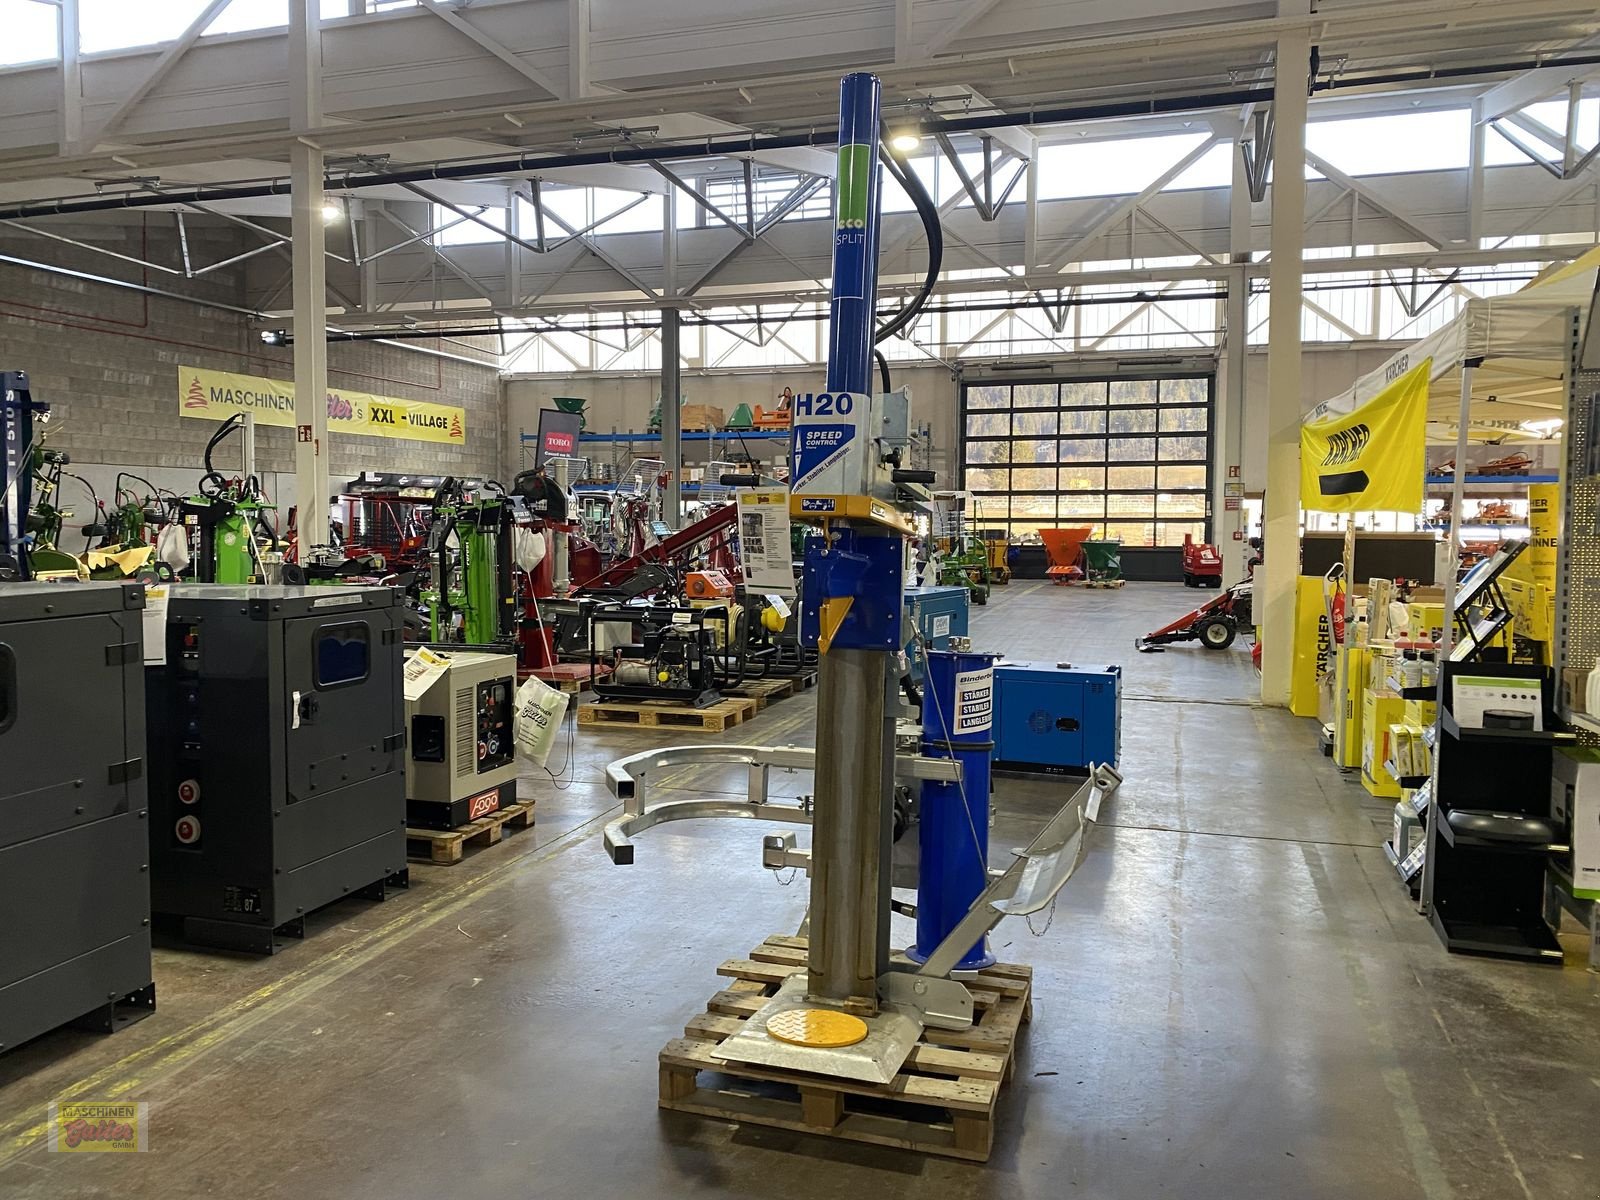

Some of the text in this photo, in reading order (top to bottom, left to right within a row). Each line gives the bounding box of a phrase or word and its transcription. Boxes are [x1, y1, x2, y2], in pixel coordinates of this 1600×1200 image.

[836, 233, 865, 246] SPLIT
[210, 386, 294, 411] MASCHINEN
[371, 407, 395, 424] XXL
[796, 393, 853, 416] H20
[547, 437, 570, 447] TORO
[806, 431, 843, 440] SPEED
[963, 688, 989, 701] STÄRKER
[527, 699, 553, 717] MASCHINEN
[963, 701, 990, 714] STABILER
